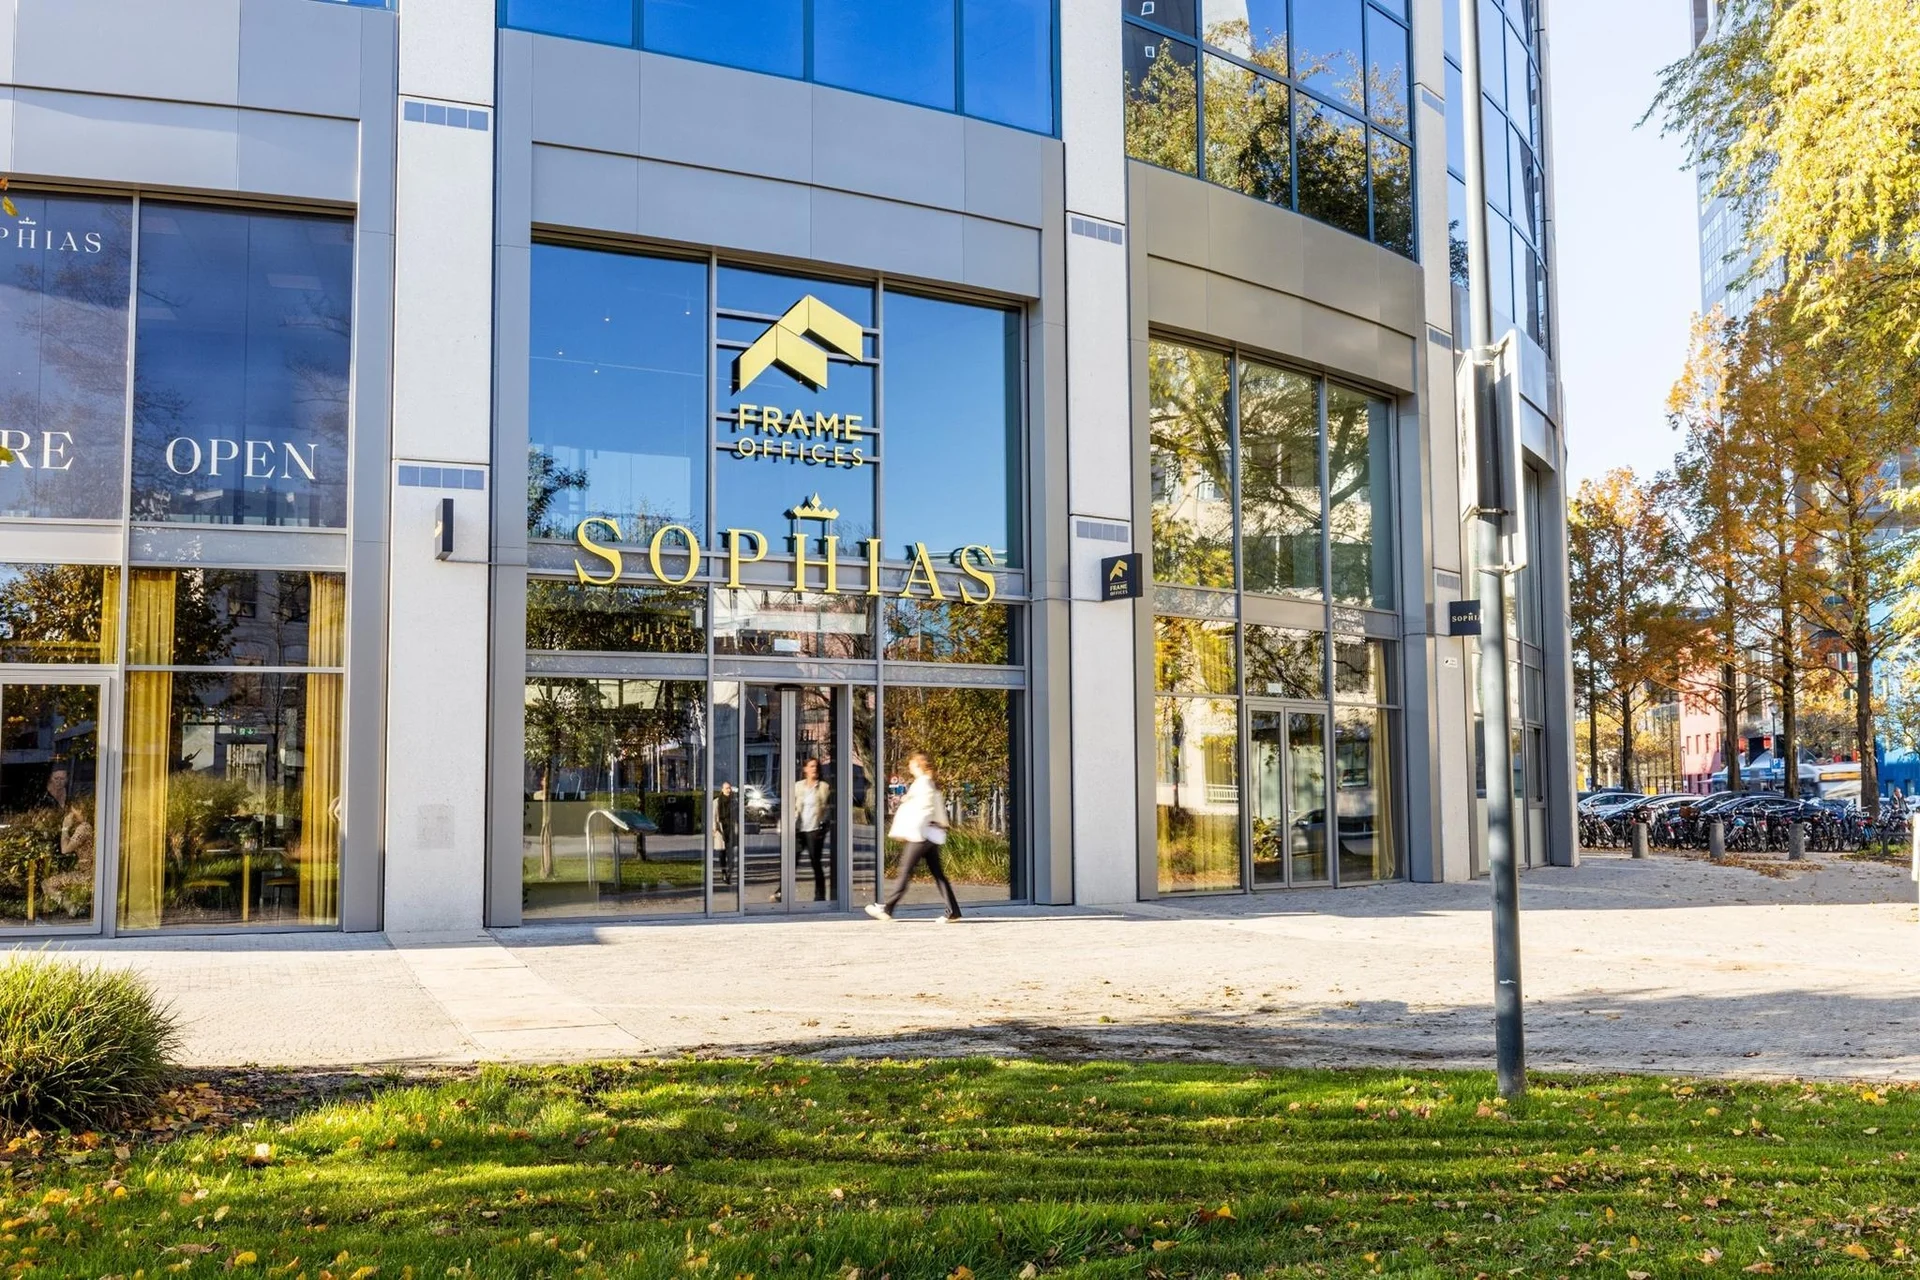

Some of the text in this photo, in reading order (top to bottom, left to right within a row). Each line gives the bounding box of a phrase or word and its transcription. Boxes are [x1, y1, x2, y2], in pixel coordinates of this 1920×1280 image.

[738, 403, 863, 441] FRAME
[165, 437, 319, 480] OPEN
[738, 437, 863, 466] OFFICES
[574, 517, 997, 605] SOPHIAS
